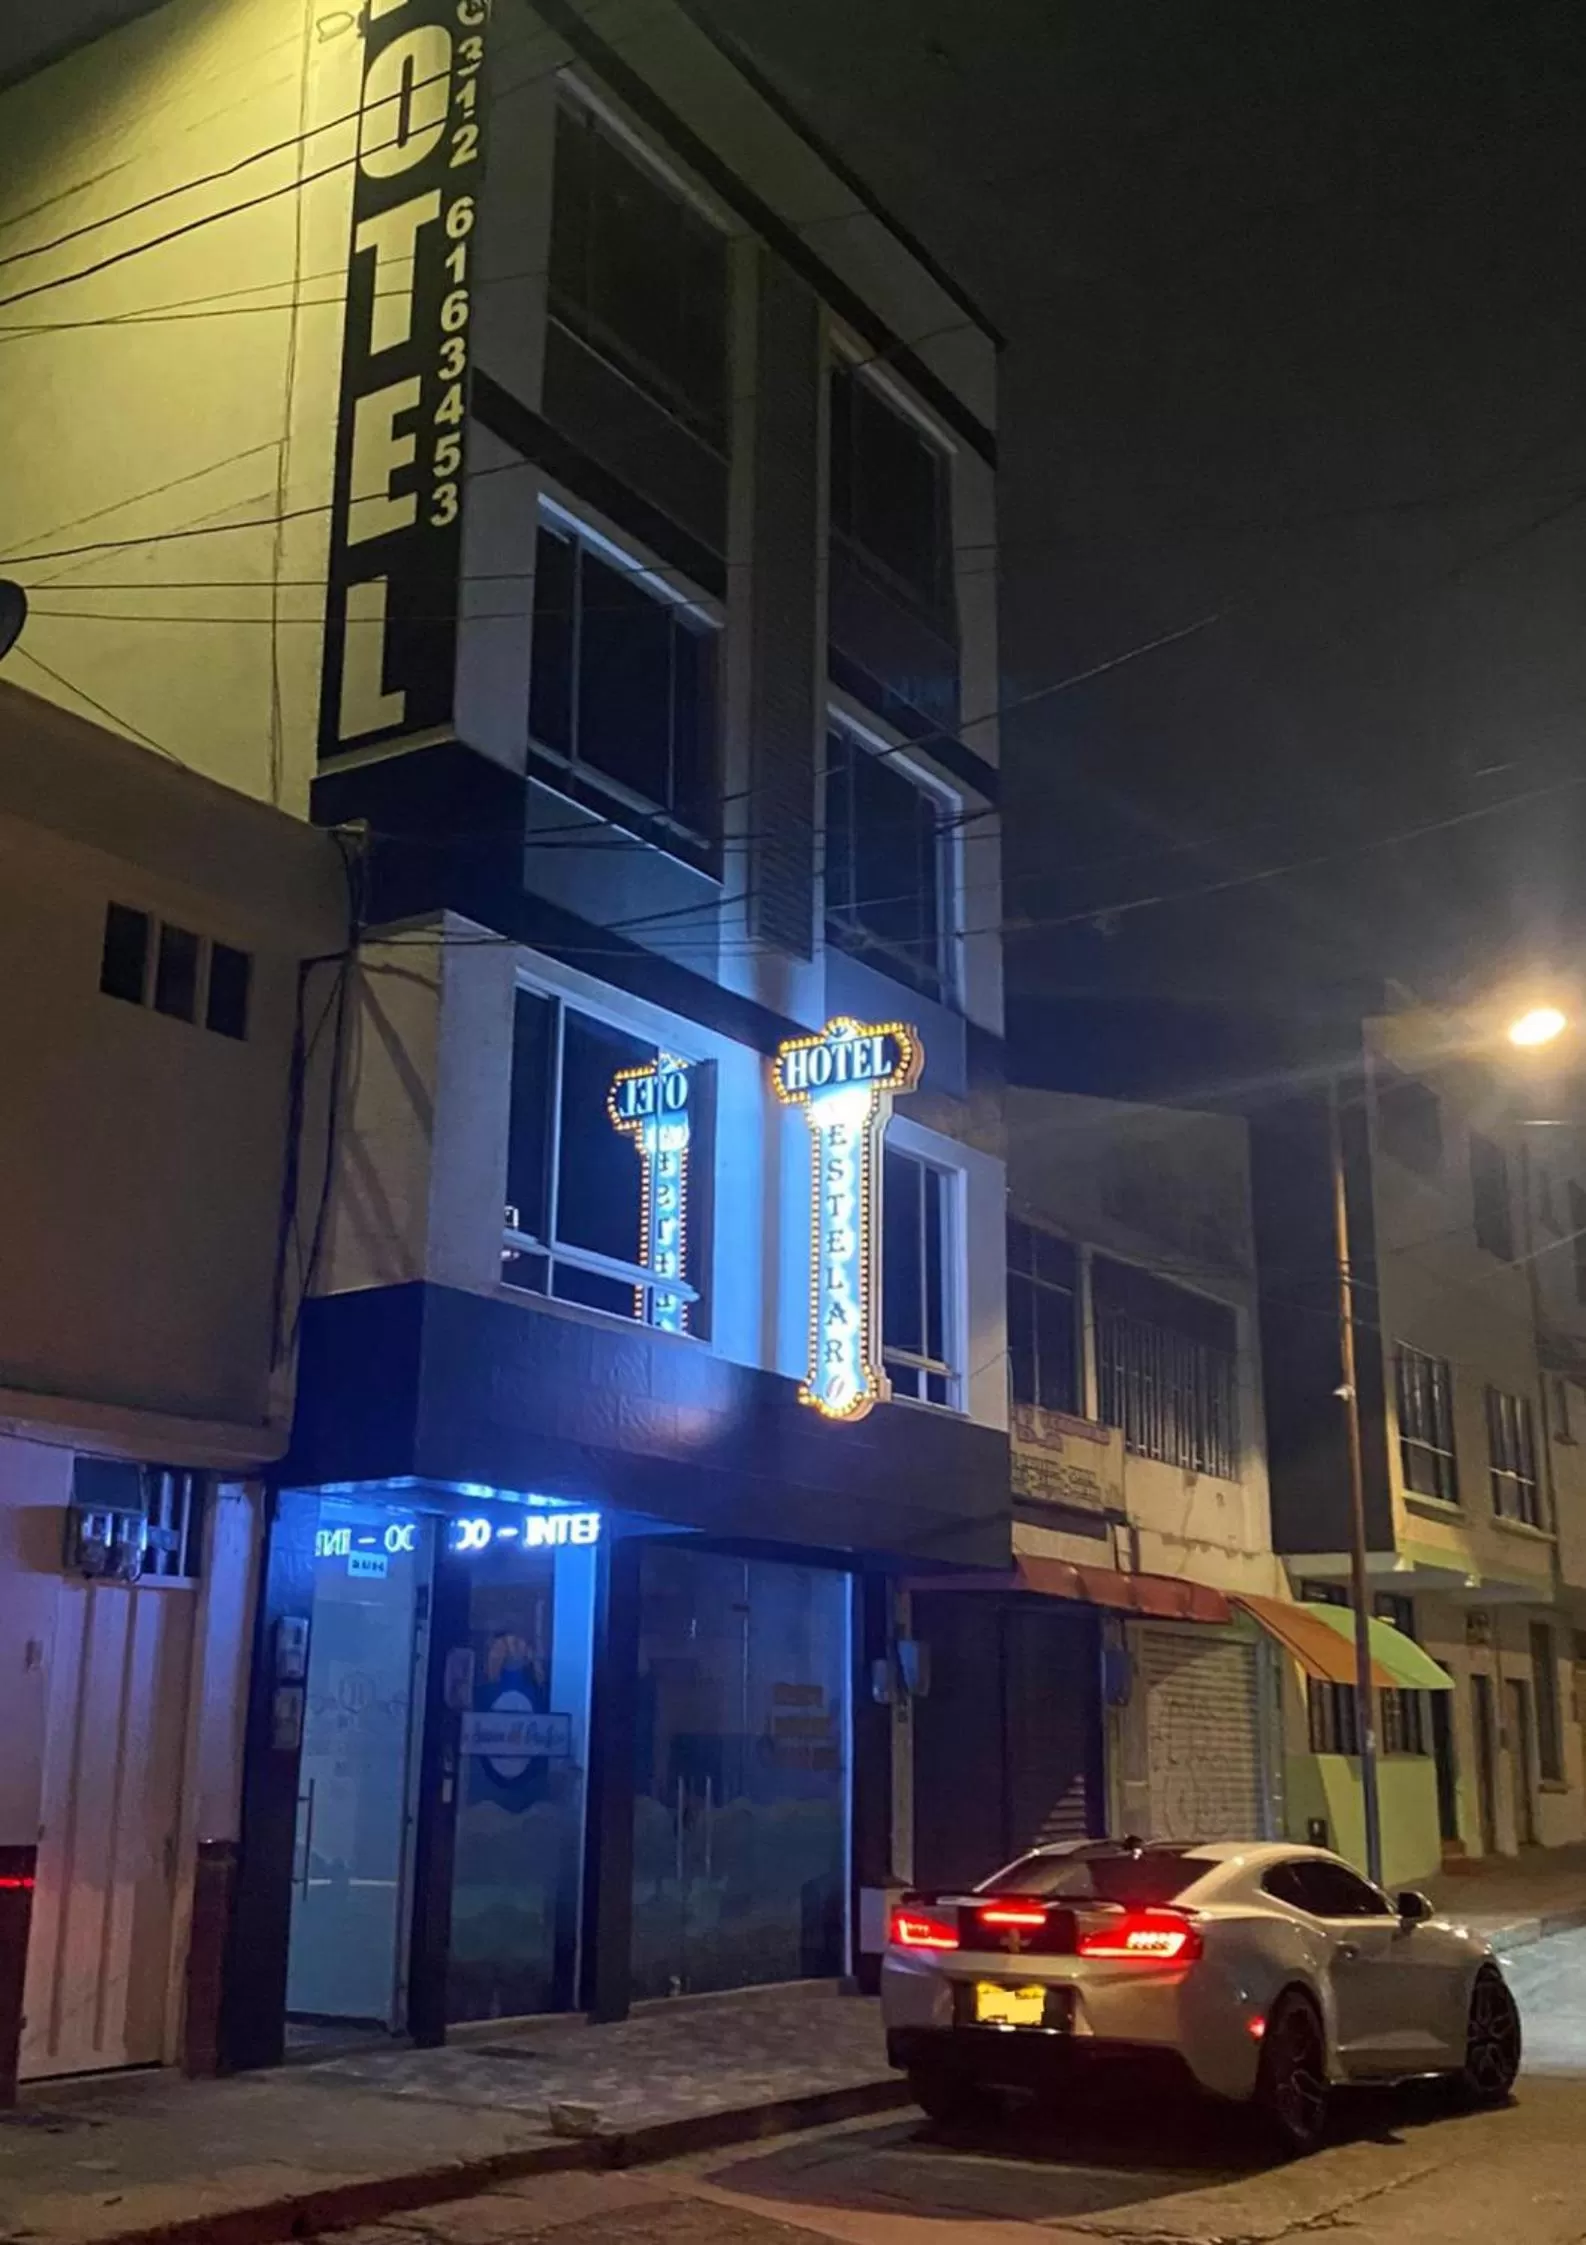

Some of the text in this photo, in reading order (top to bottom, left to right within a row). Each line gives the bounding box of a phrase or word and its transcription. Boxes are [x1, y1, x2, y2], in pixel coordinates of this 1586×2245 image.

[338, 0, 452, 740] OTEL
[430, 196, 474, 526] 6163453
[785, 1035, 893, 1091] HOTEL
[824, 1122, 849, 1365] ESTELAR
